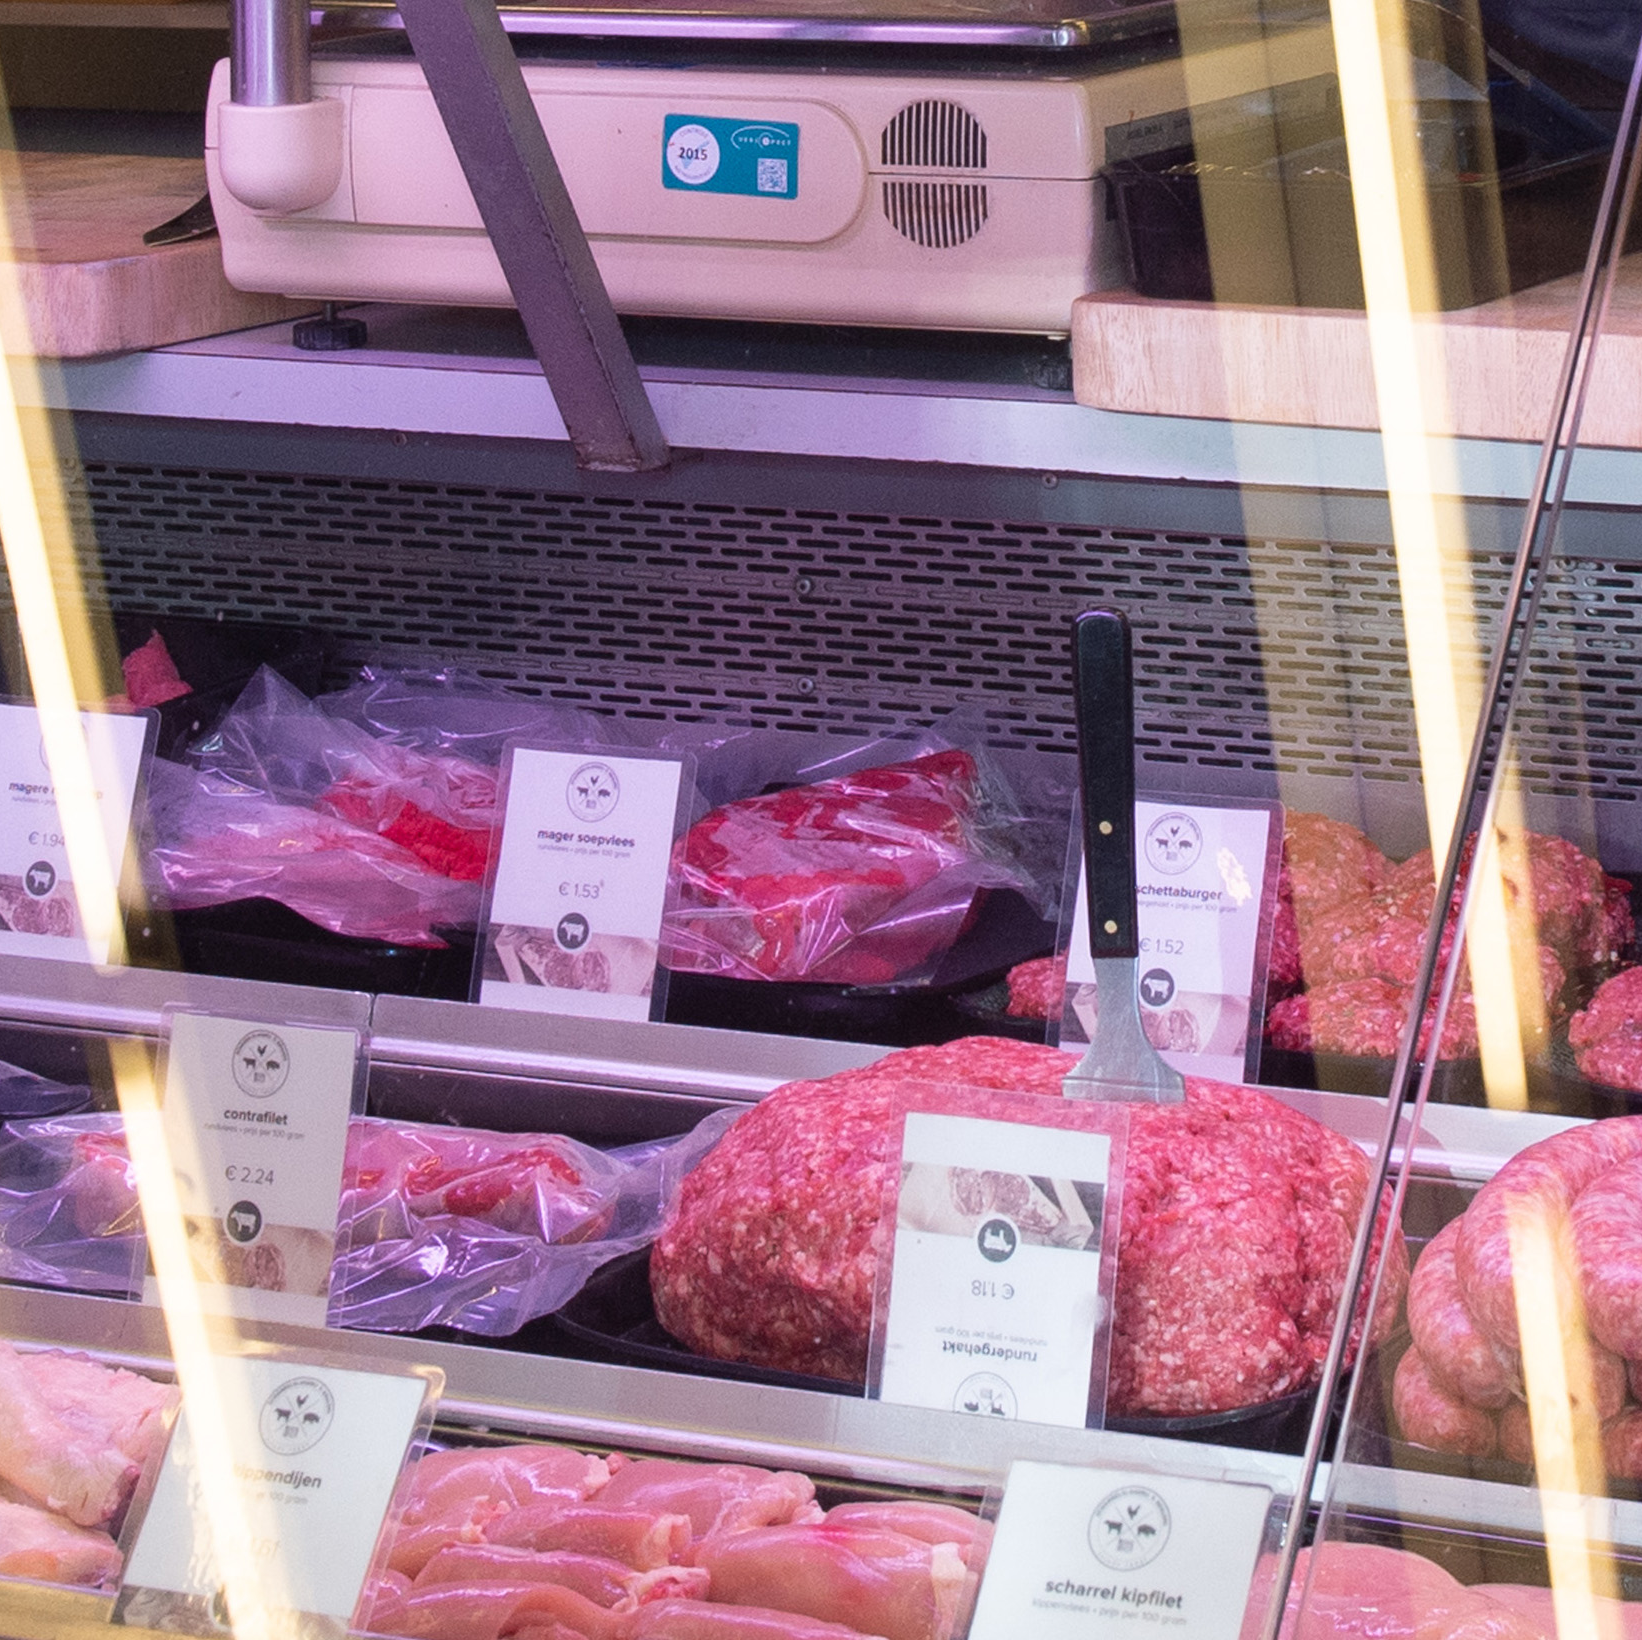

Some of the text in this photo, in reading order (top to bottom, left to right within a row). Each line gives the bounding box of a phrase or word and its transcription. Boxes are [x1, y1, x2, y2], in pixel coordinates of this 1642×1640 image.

[679, 147, 707, 160] 2015
[9, 782, 49, 795] magere
[29, 831, 39, 845] €
[537, 830, 635, 847] mager soepvlees
[559, 882, 600, 899] € 1.53
[1139, 938, 1184, 955] € 1.52
[224, 1109, 288, 1125] contrafilet
[225, 1165, 274, 1185] € 2.24
[971, 1280, 1015, 1300] € 1.18
[943, 1340, 1037, 1361] rundergehakt
[1045, 1579, 1183, 1609] scharrel kipfilet
